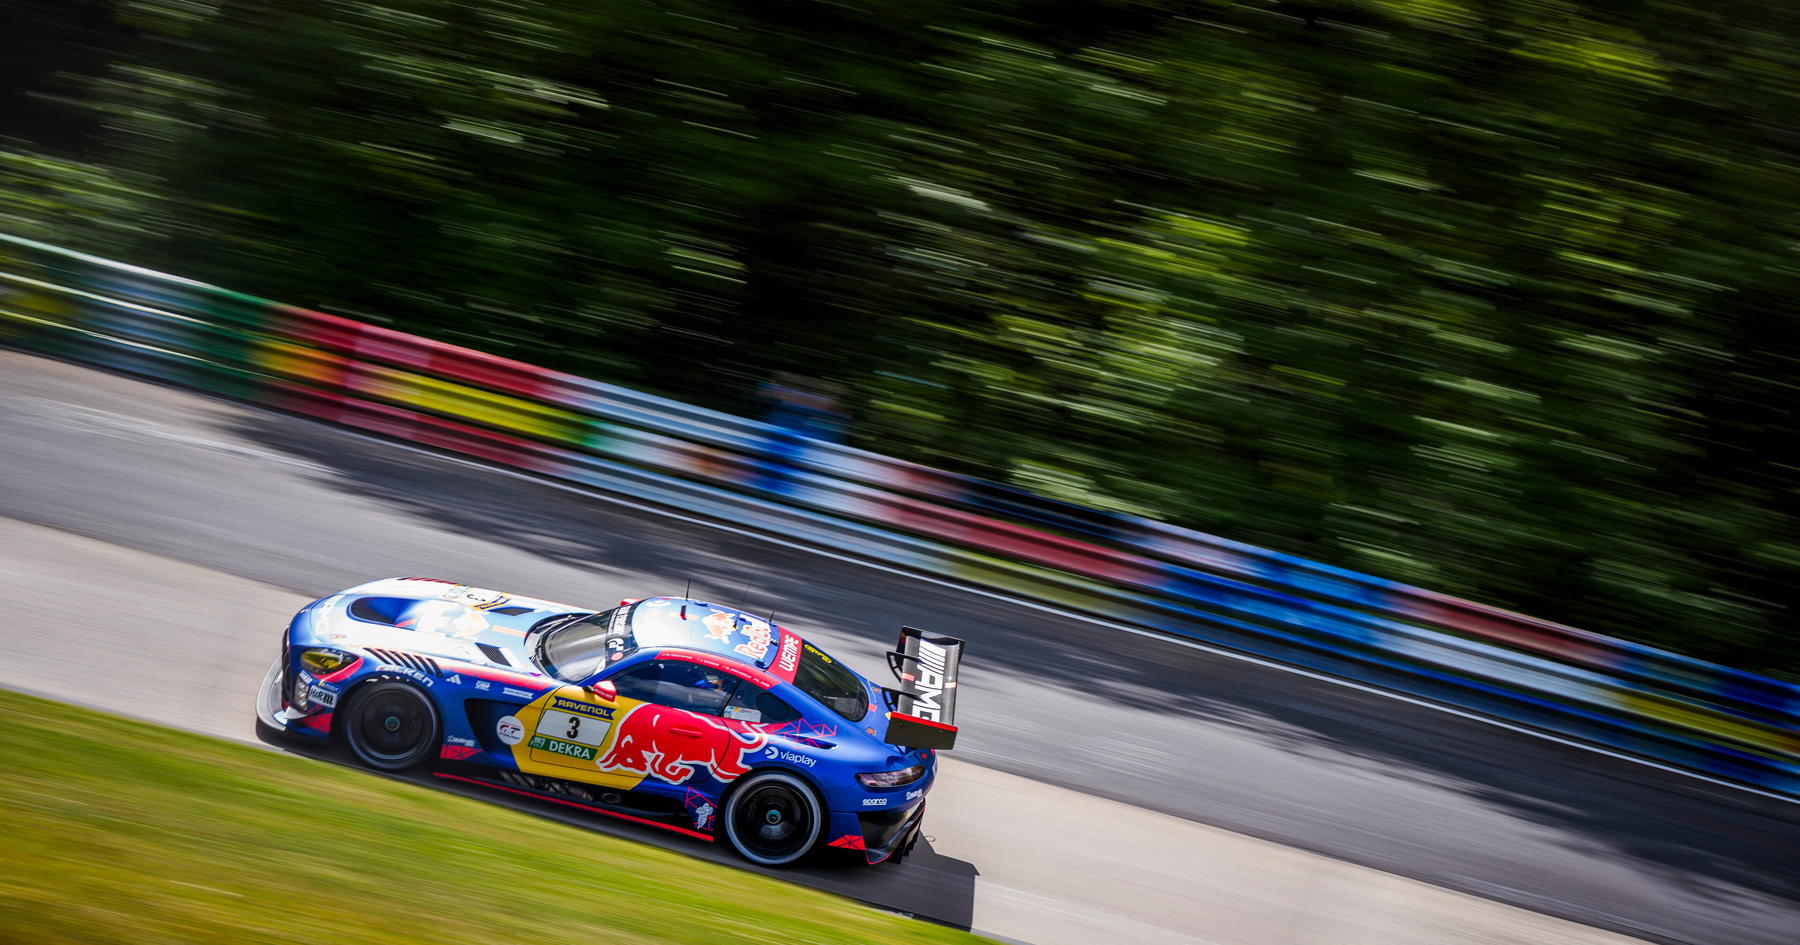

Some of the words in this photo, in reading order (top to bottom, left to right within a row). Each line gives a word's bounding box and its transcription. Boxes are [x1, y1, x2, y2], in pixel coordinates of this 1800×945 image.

[557, 700, 610, 717] RAVENOL
[566, 716, 581, 739] 3
[549, 740, 590, 759] DEKRA
[780, 751, 817, 767] viaplay
[862, 798, 888, 806] sparco
